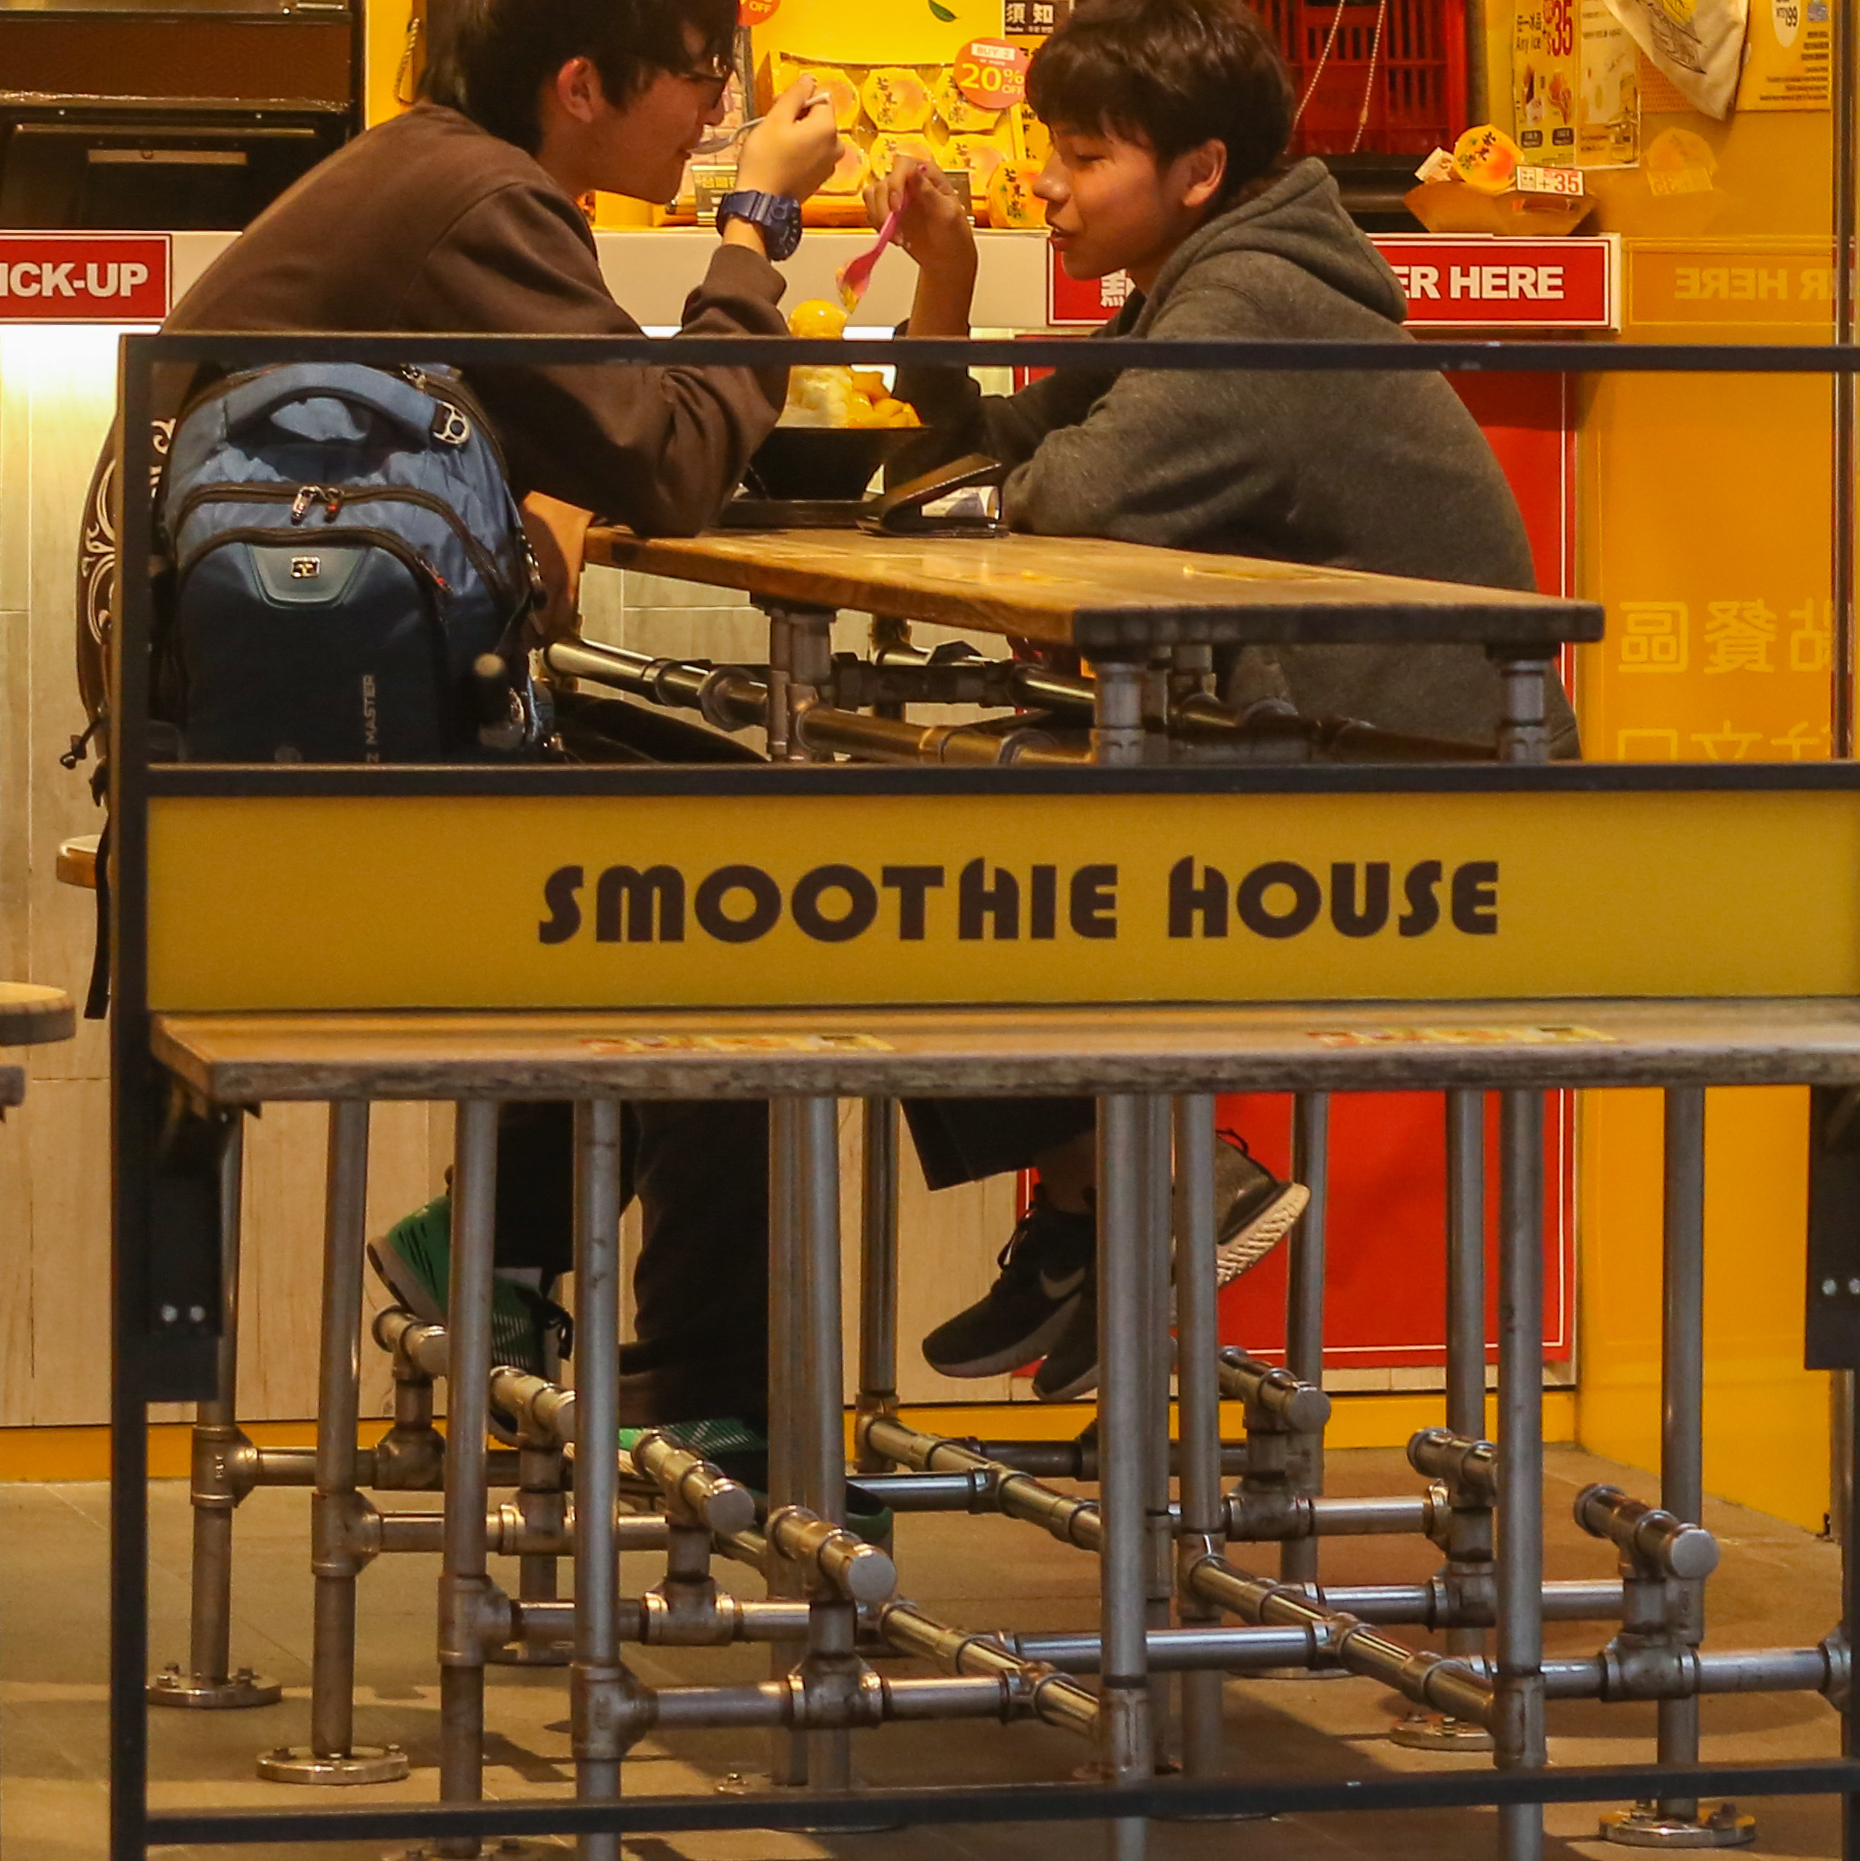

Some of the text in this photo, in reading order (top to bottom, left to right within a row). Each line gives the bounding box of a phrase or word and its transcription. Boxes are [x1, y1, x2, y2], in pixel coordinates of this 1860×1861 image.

[749, 1, 772, 14] OFF
[1005, 2, 1055, 25] 須知
[976, 45, 999, 58] BUY
[961, 63, 1025, 92] 20%
[1001, 83, 1025, 95] OFF
[1450, 266, 1564, 301] HERE
[538, 853, 1500, 945] SMOOTHIE HOUSE
